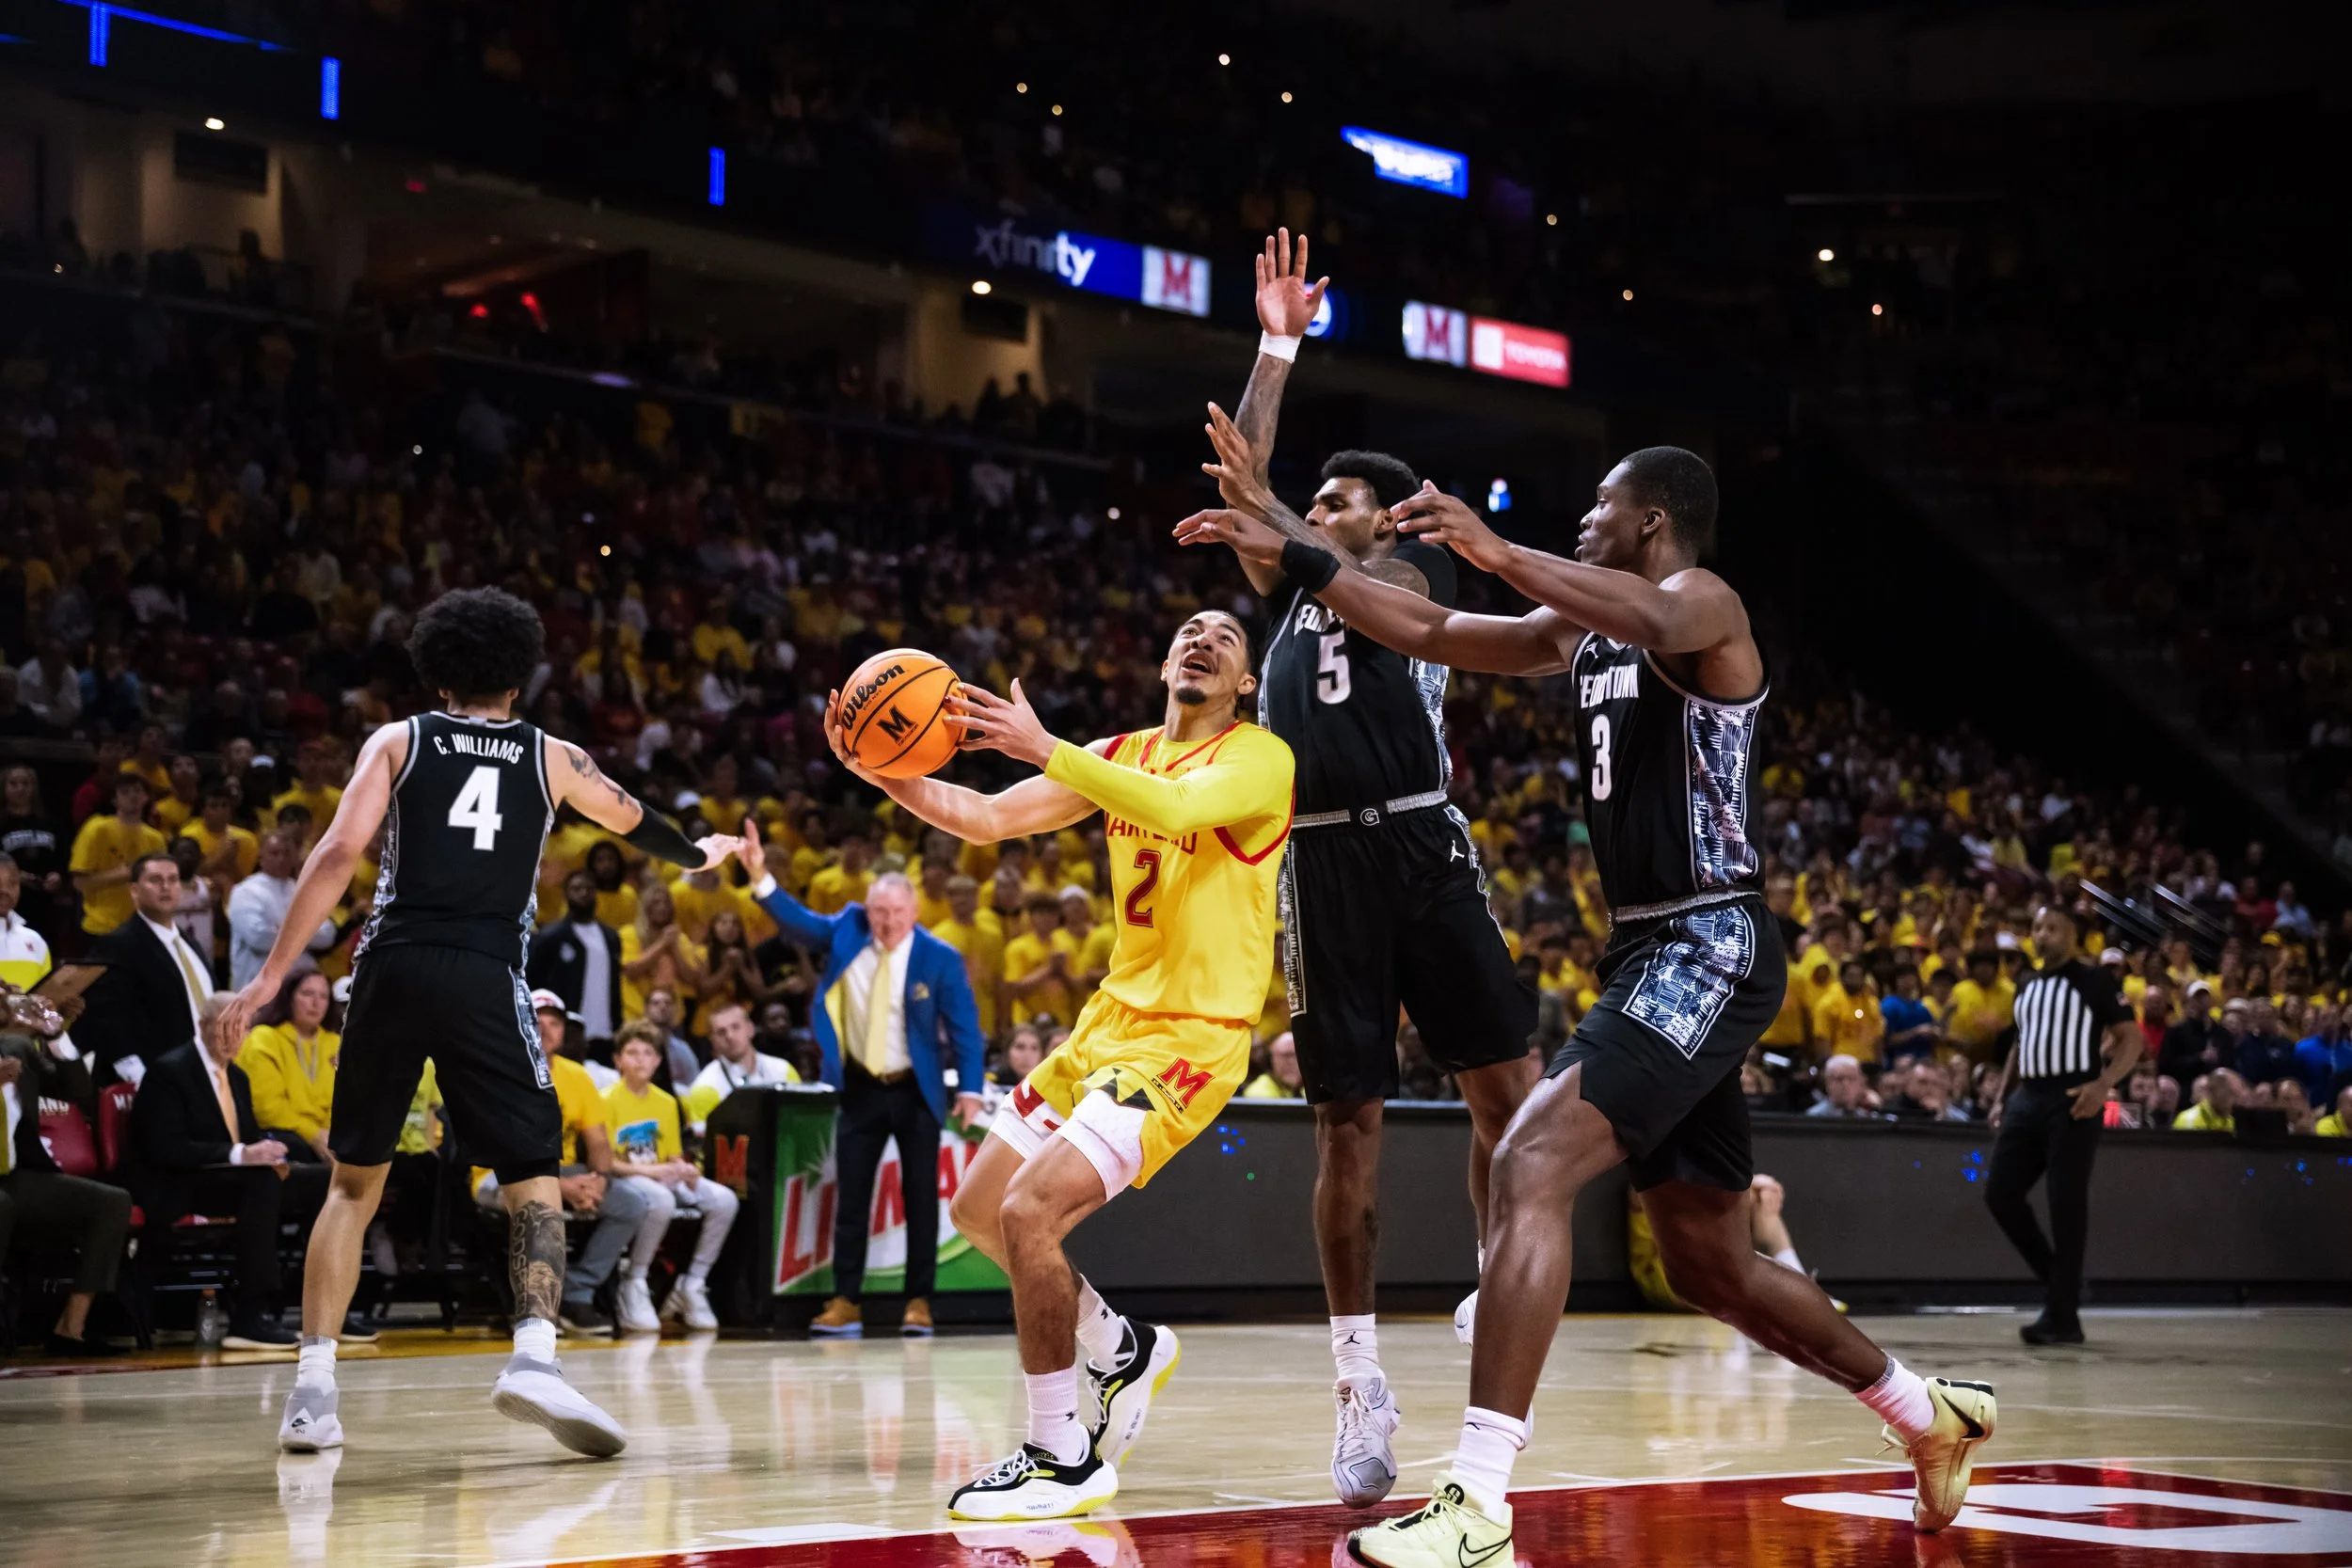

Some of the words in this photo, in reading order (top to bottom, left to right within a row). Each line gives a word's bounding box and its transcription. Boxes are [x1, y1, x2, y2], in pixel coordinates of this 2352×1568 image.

[841, 664, 906, 731] Wilson
[1318, 628, 1352, 705] 5
[433, 736, 452, 755] C.
[451, 733, 524, 764] WILLIAMS
[876, 705, 916, 744] M
[1591, 713, 1613, 801] 3
[448, 765, 503, 851] 4
[1124, 848, 1162, 928] 2
[1155, 1055, 1216, 1111] M
[715, 1133, 749, 1199] M
